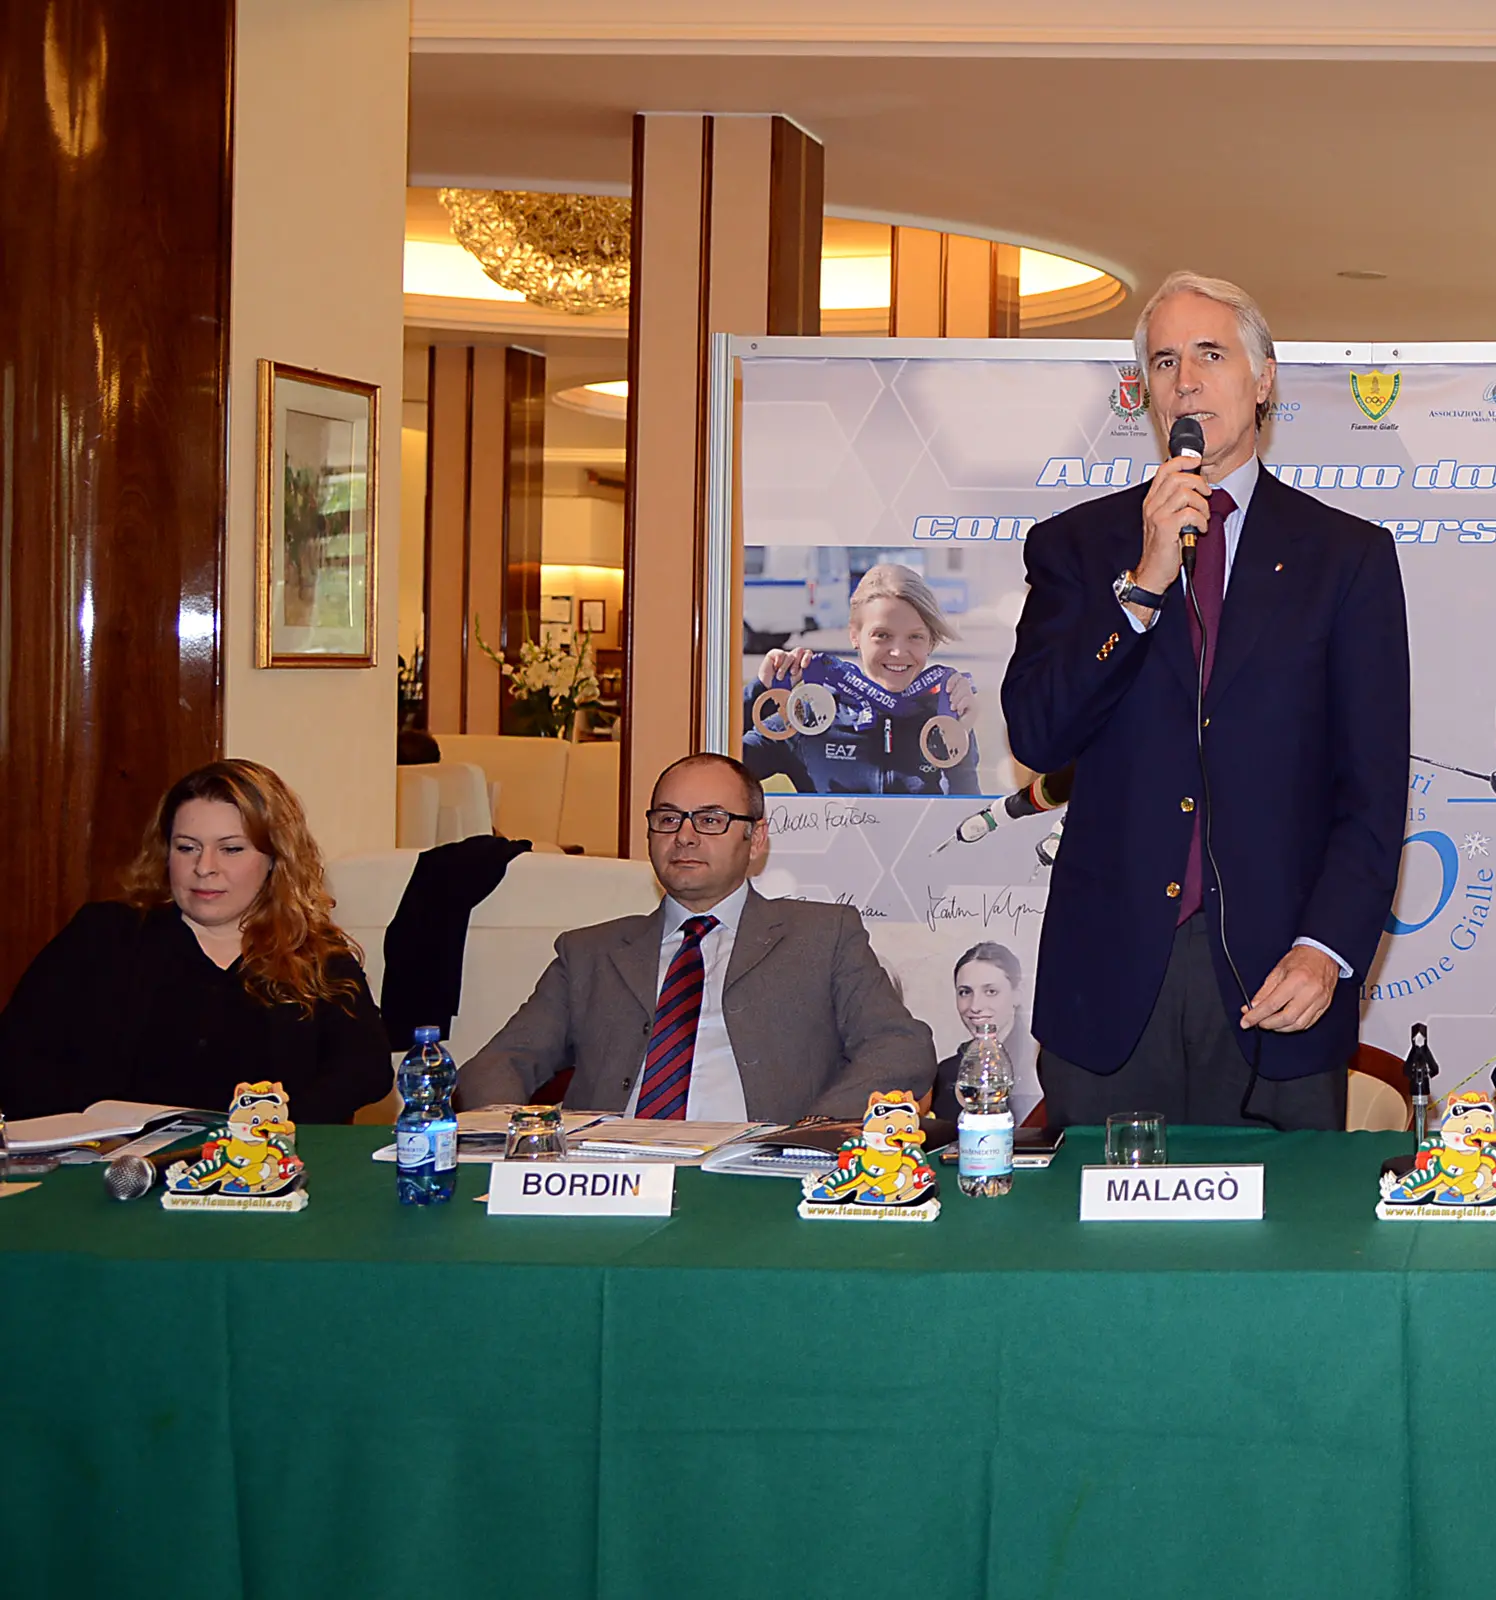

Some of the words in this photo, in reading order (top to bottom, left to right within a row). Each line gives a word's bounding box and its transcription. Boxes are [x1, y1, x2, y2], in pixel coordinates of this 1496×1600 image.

[1351, 422, 1377, 431] Fiamme
[1379, 422, 1399, 431] Gialle
[1036, 457, 1132, 488] Ad
[1263, 464, 1405, 490] nno
[825, 743, 857, 757] EA7
[1359, 955, 1455, 1001] iamme
[1450, 867, 1495, 951] Gialle
[522, 1172, 641, 1197] BORDIN
[1107, 1171, 1239, 1202] MALAGÒ
[171, 1196, 293, 1210] www.fiammegialle.org
[807, 1205, 929, 1219] www.fiammegialle.org
